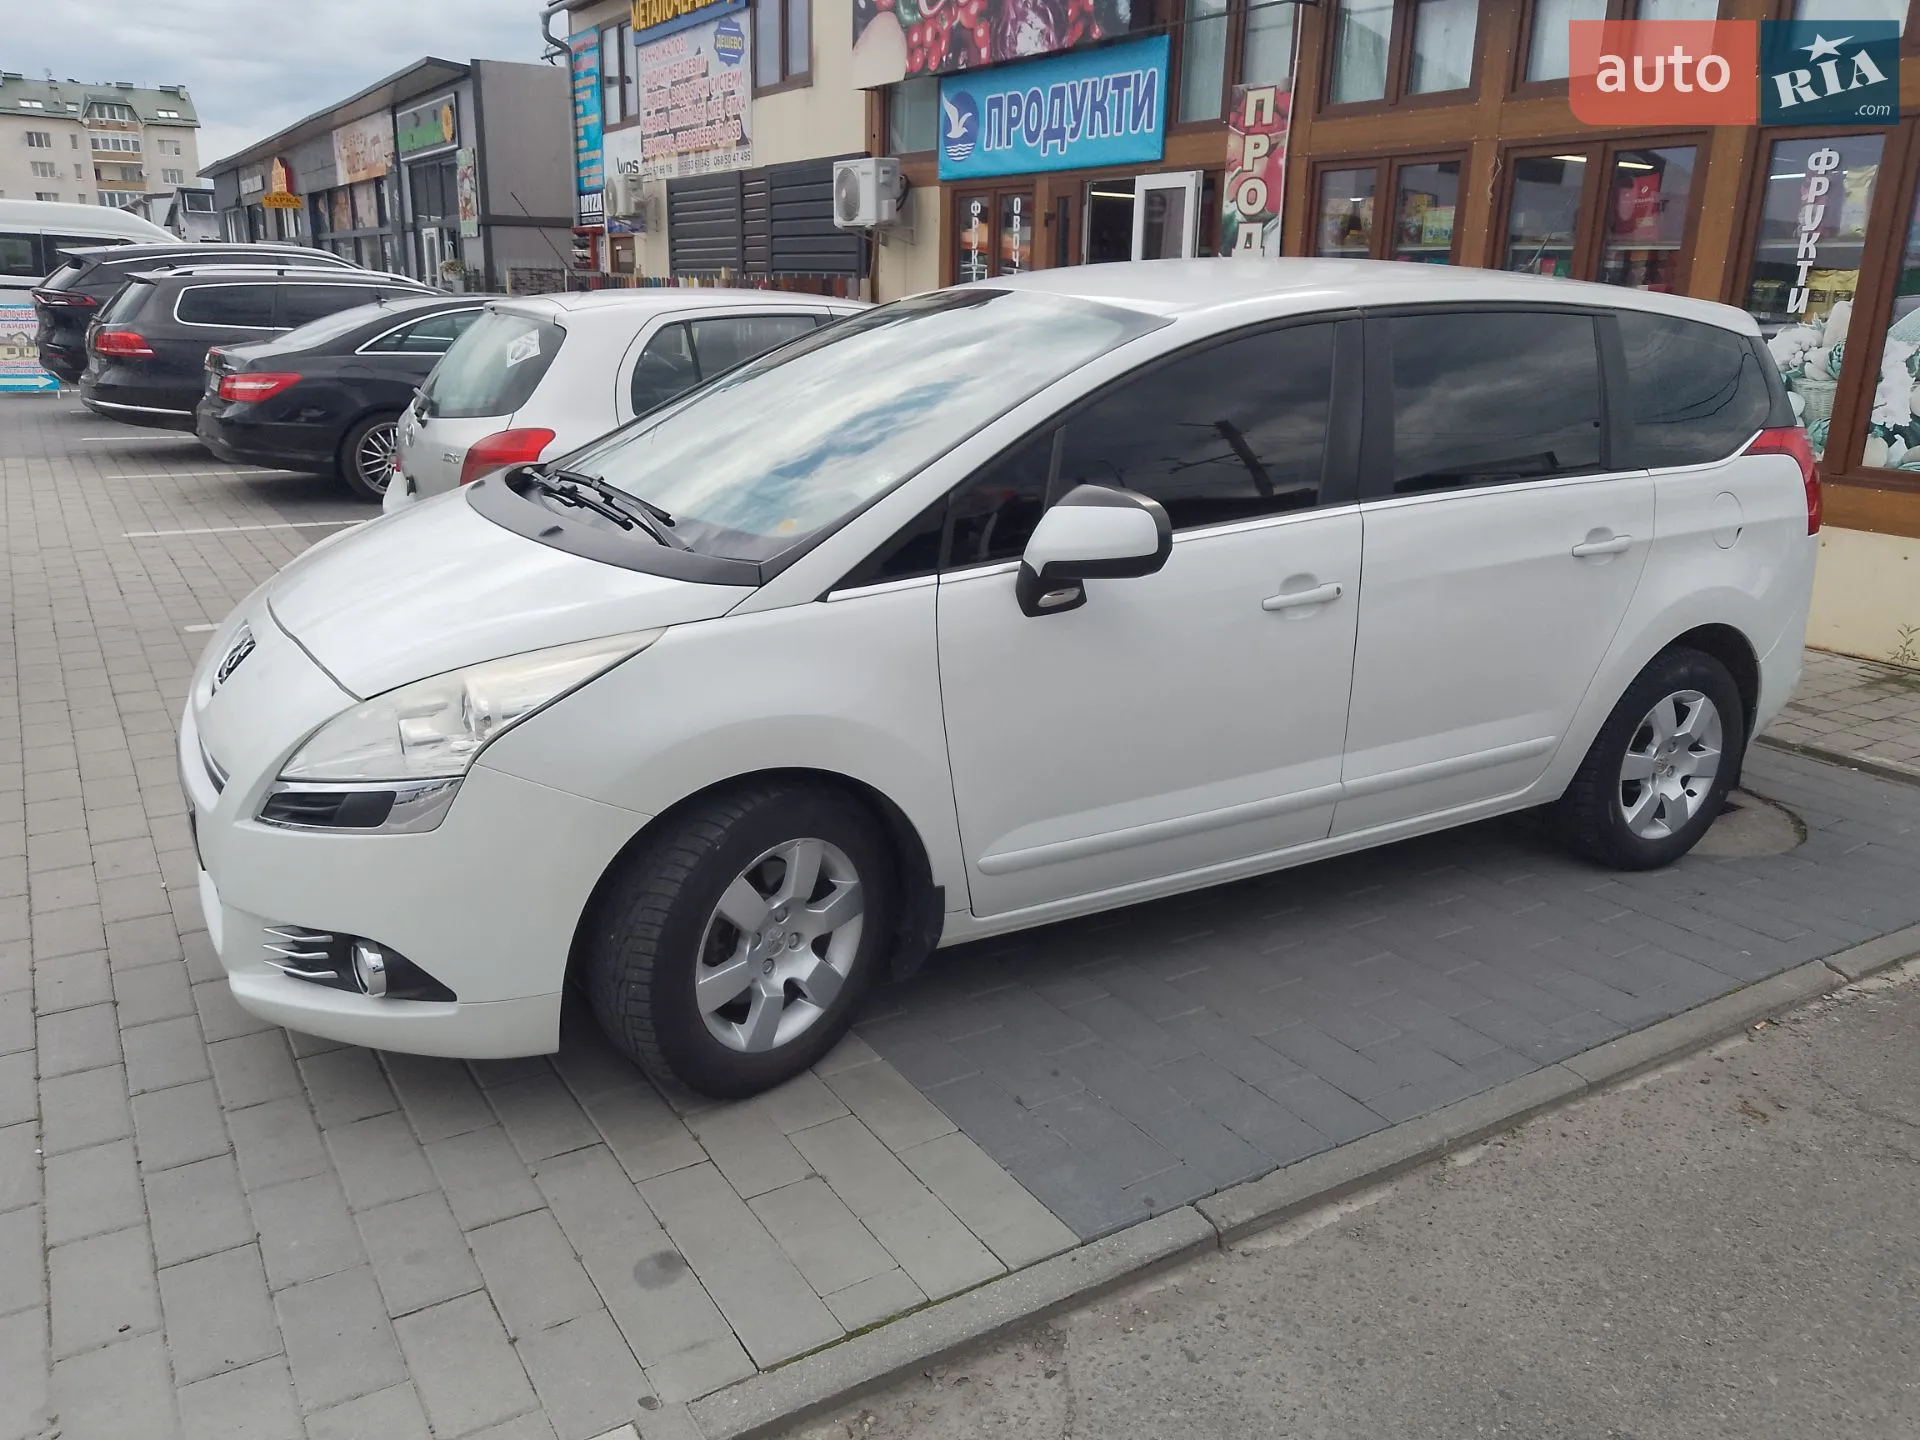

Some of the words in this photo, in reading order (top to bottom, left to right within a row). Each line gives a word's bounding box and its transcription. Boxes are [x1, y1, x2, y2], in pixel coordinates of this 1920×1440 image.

[716, 34, 742, 49] ДЕШЕВО
[710, 68, 744, 94] СИСТЕМИ
[984, 67, 1158, 157] ПРОДУКТИ
[732, 152, 739, 162] 47
[740, 150, 751, 161] 495
[264, 196, 301, 204] ЧАРКА
[1786, 147, 1840, 314] ФРУКТИ
